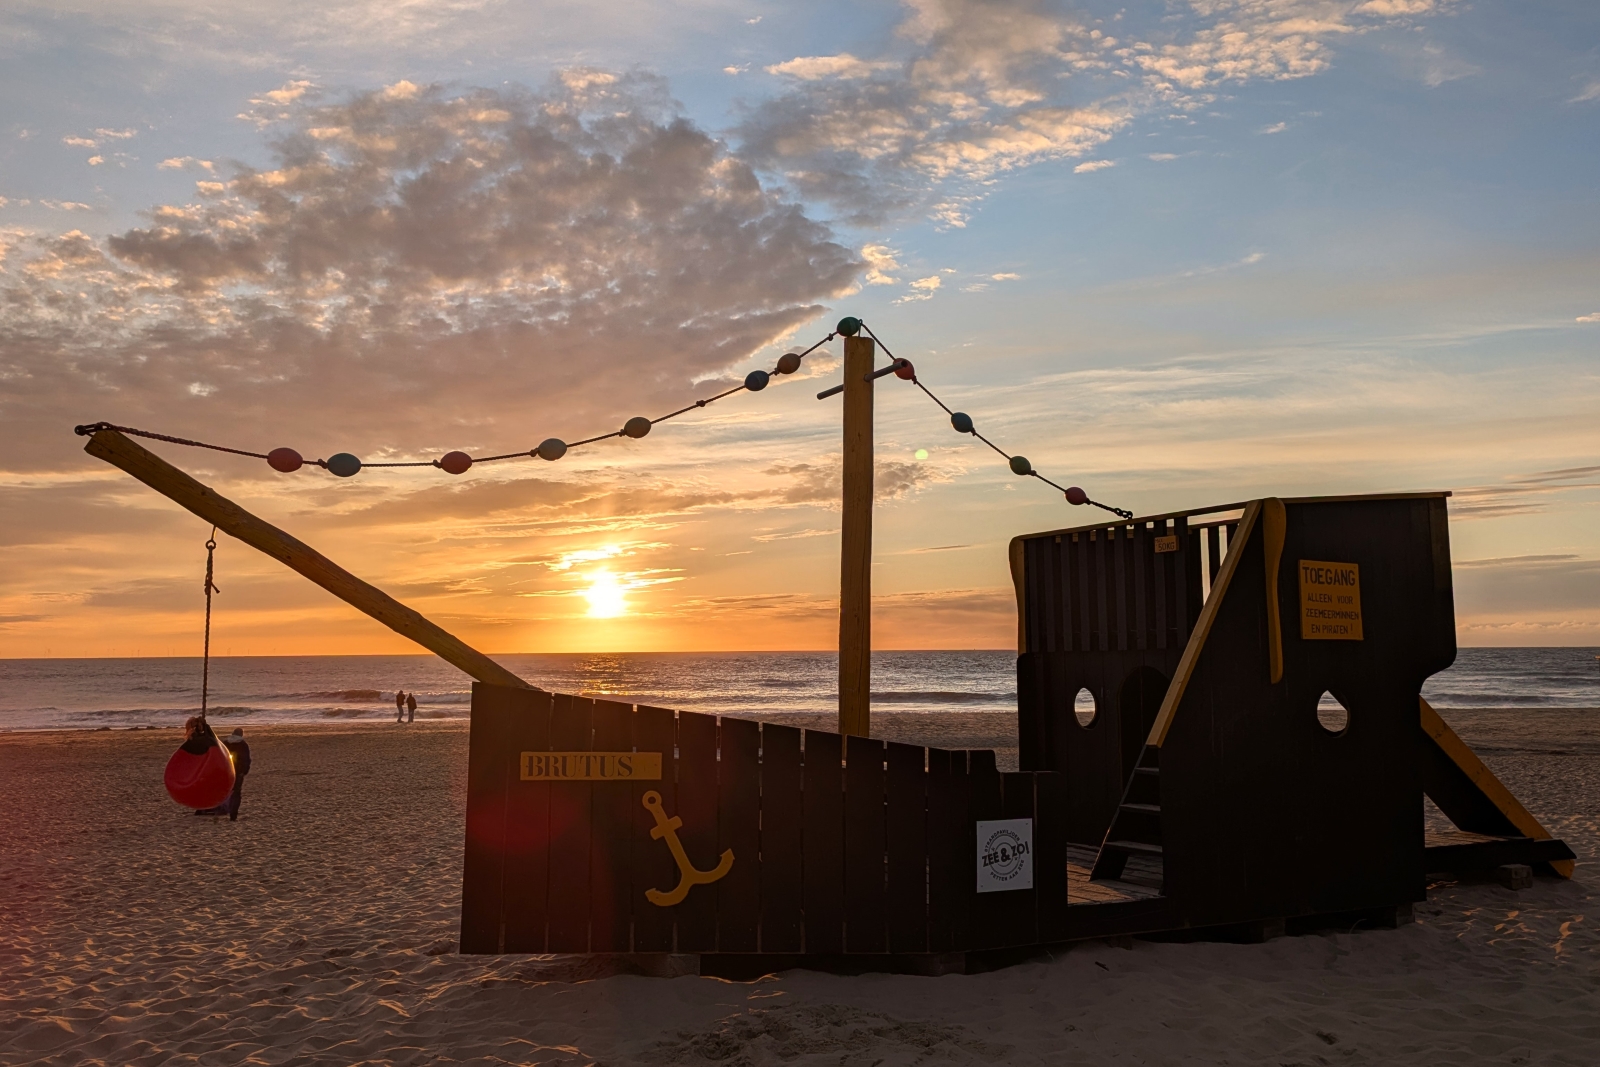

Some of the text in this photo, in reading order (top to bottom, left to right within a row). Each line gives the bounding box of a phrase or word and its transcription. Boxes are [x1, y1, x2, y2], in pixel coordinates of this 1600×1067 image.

[1302, 566, 1356, 586] TOEGANG
[1307, 592, 1354, 605] ALLEEN VOOR
[1311, 623, 1321, 634] EN
[527, 755, 633, 777] BRUTUS
[981, 841, 1030, 867] ZEE & ZO!
[1009, 871, 1019, 880] AAN
